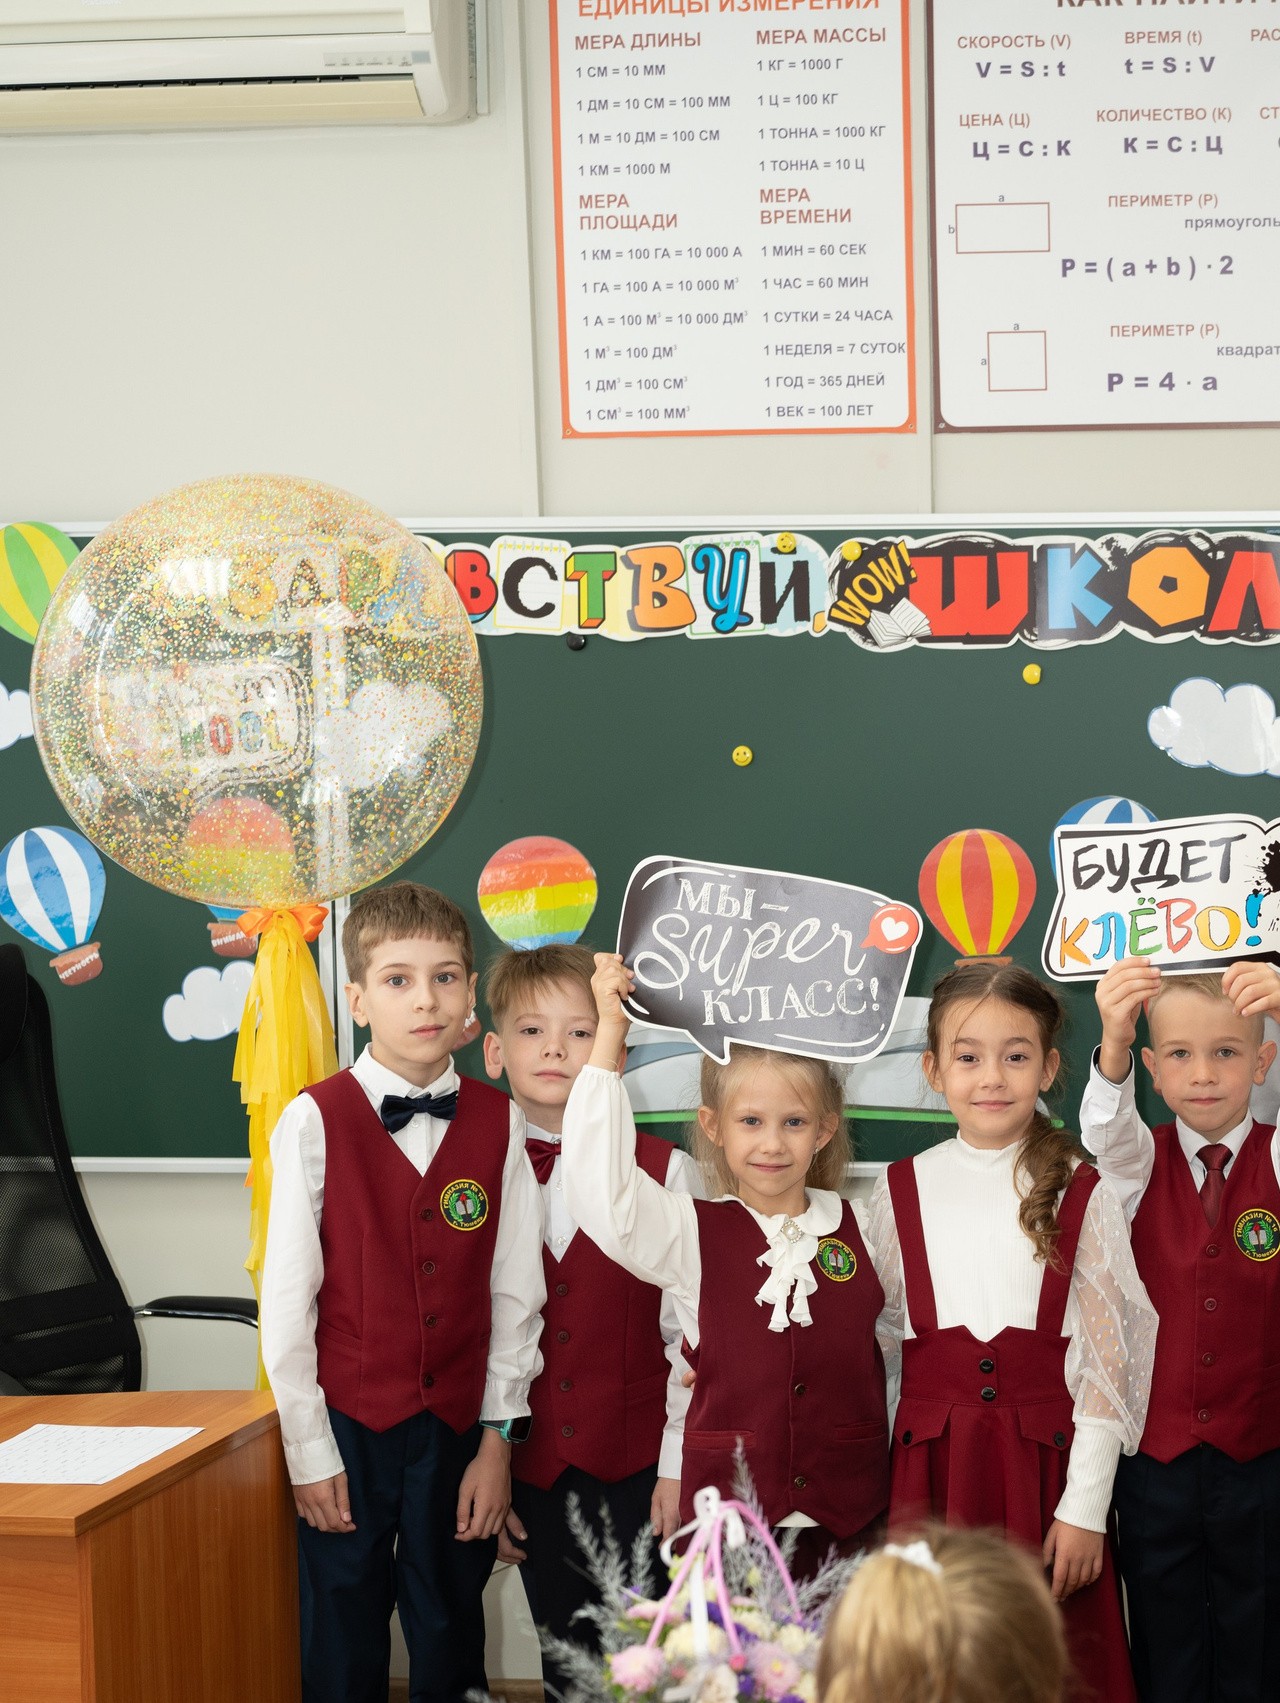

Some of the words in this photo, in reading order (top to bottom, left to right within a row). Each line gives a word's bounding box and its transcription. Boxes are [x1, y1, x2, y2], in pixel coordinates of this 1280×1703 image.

[579, 0, 709, 18] ЕДИНИЦЫ
[575, 35, 625, 50] МЕРА
[631, 32, 700, 51] ДЛИНЫ
[757, 30, 807, 44] МЕРА
[814, 28, 885, 43] МАССЫ
[958, 35, 1045, 48] СКОРОСТЬ
[1051, 35, 1071, 50] (V)
[1125, 31, 1181, 44] ВРЕМЯ
[1187, 31, 1202, 45] (t)
[756, 60, 763, 71] 1
[769, 60, 784, 70] КГ
[801, 59, 831, 70] 1000
[836, 59, 843, 69] Г
[976, 62, 991, 78] V
[1000, 65, 1011, 74] =
[1021, 61, 1034, 77] S
[1057, 61, 1065, 76] t
[960, 114, 1003, 129] ЦЕНА
[1009, 113, 1030, 128] (Ц)
[1097, 108, 1206, 122] КОЛИЧЕСТВО
[1212, 108, 1231, 123] (К)
[580, 194, 629, 209] МЕРА
[760, 188, 810, 203] МЕРА
[1109, 194, 1193, 207] ПЕРИМЕТР
[1199, 194, 1218, 208] (P)
[580, 214, 677, 231] ПЛОЩАДИ
[761, 209, 851, 224] ВРЕМЕНИ
[762, 279, 768, 289] 1
[774, 278, 801, 289] ЧАС
[819, 277, 833, 288] 60
[838, 277, 868, 287] МИН
[1111, 324, 1194, 337] ПЕРИМЕТР
[1200, 324, 1219, 338] (P)
[830, 541, 918, 627] WOW!
[1073, 833, 1247, 894] БУДЕТ
[1060, 892, 1264, 970] КЛЁВО!
[634, 913, 868, 1001] Super
[59, 952, 99, 980] ЧЕСТНОСТЬ
[702, 981, 881, 1027] КЛАСС!
